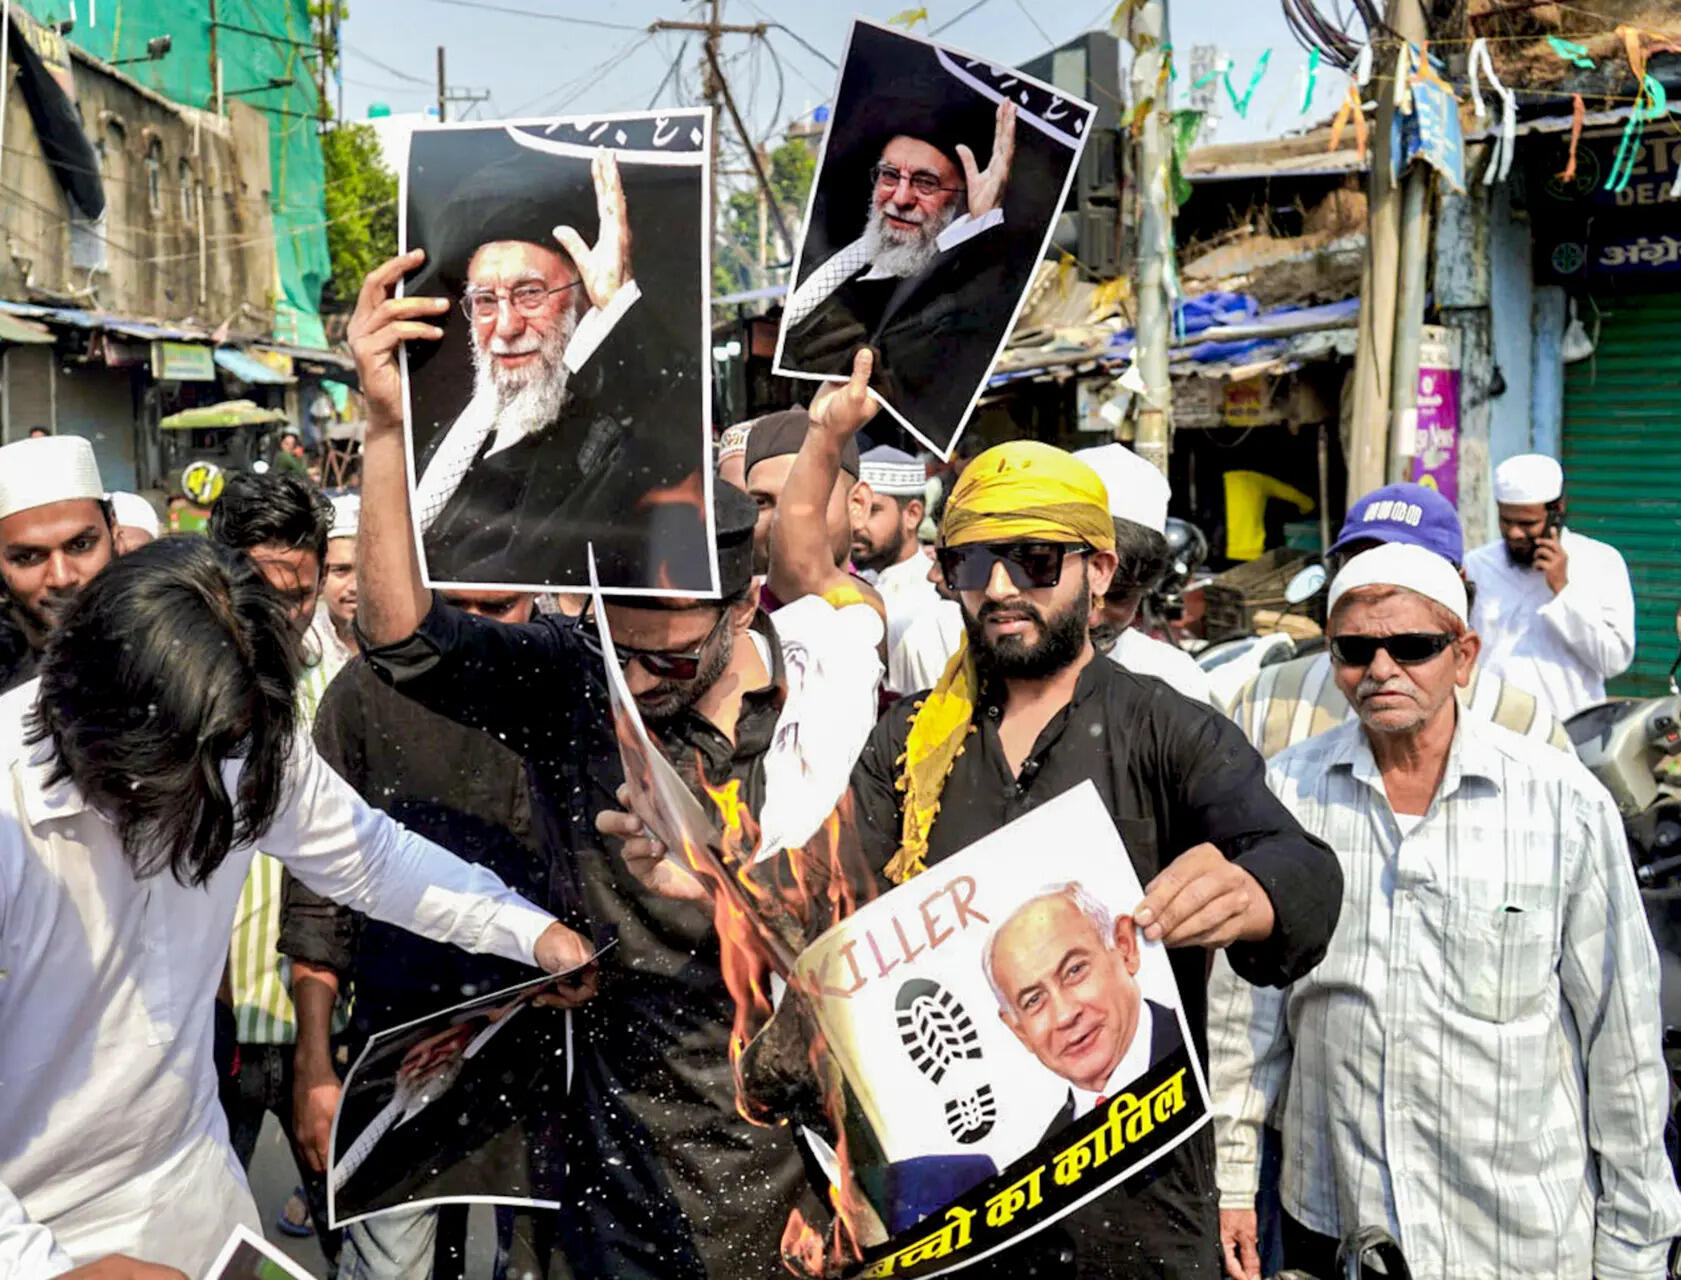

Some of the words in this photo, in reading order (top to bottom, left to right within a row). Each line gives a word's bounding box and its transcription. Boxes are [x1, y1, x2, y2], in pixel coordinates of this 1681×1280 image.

[806, 875, 990, 1001] KILLER
[985, 1165, 1046, 1228] का
[1053, 1067, 1187, 1186] कातिल
